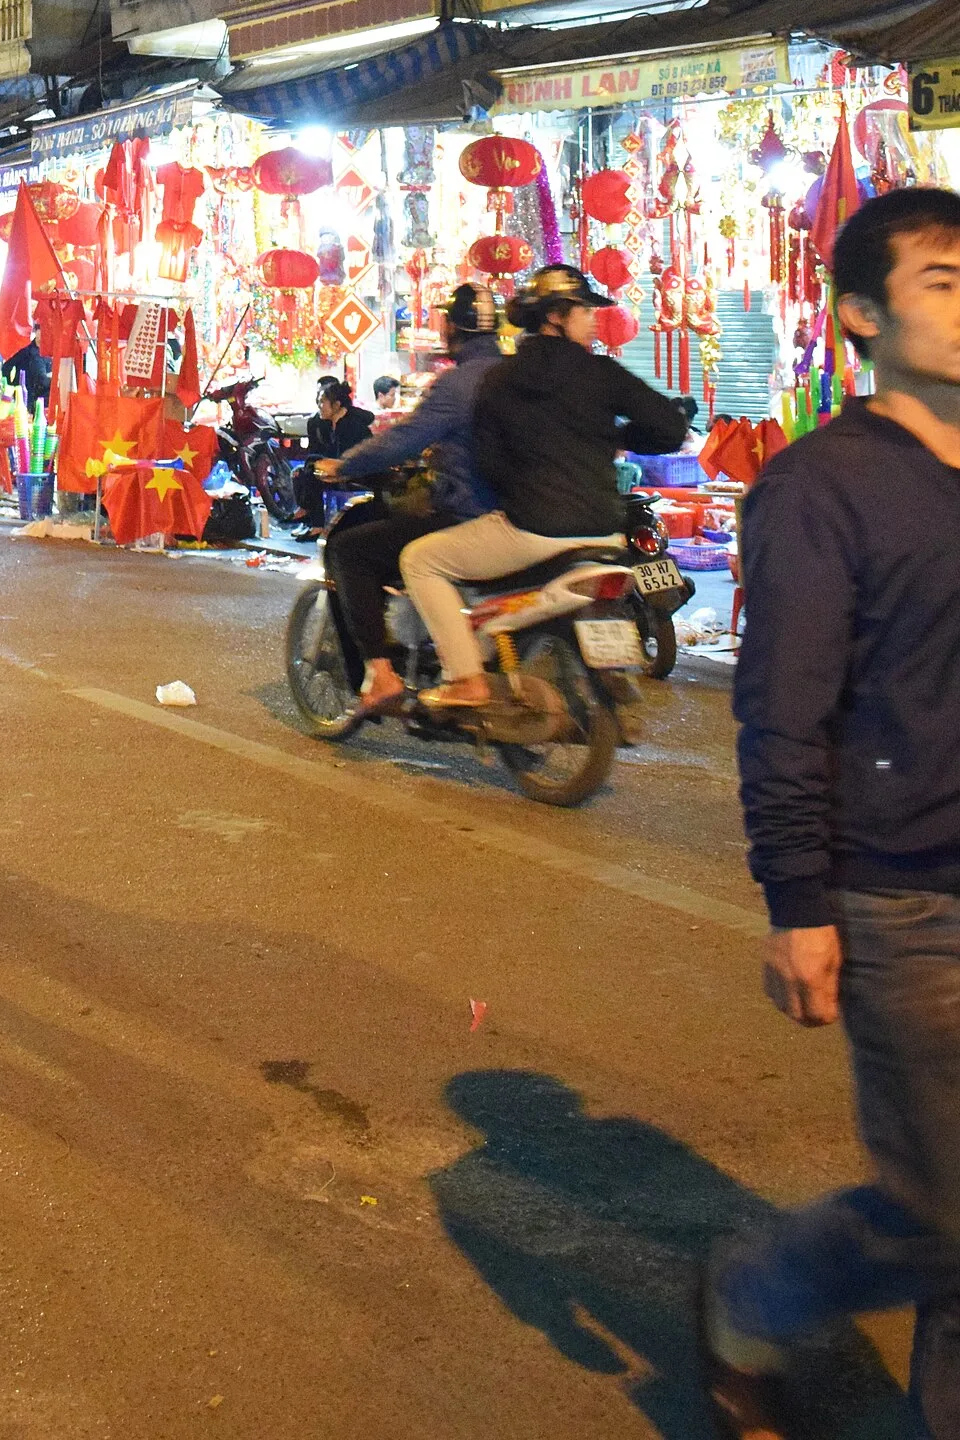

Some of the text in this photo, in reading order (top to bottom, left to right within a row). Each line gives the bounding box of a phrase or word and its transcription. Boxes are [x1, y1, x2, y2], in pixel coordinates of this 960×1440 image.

[581, 68, 640, 97] LAN
[637, 561, 669, 578] 30-H7
[643, 573, 678, 591] 6542
